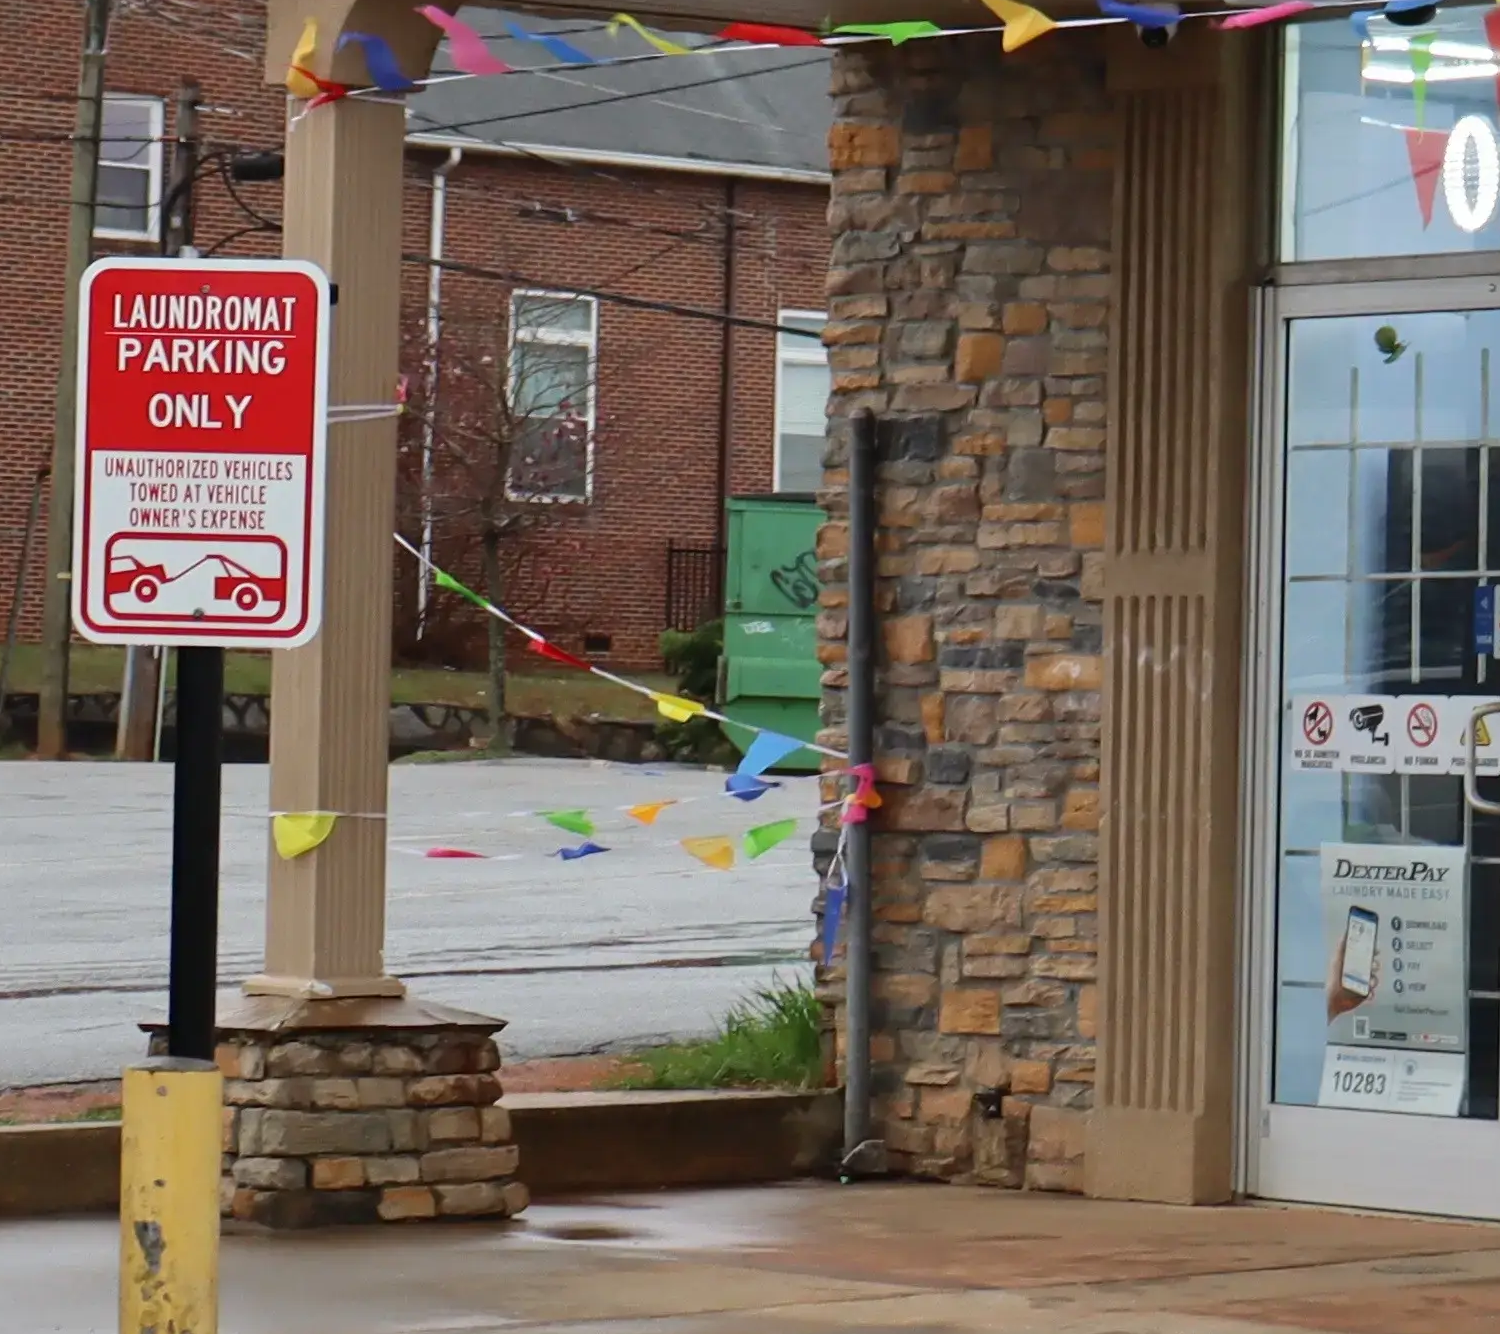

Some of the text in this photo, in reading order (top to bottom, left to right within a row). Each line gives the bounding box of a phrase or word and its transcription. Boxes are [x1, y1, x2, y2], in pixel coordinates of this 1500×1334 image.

[114, 293, 296, 332] LAUNDROMAT
[118, 338, 286, 374] PARKING
[148, 393, 252, 429] ONLY
[105, 457, 293, 481] UNAUTHORIZED VEHICLES
[130, 483, 267, 505] TOWED AT VEHICLE
[130, 508, 265, 530] OWNER'S EXPENSE
[1386, 887, 1416, 899] MADE
[1421, 888, 1450, 900] EASY
[1333, 1071, 1386, 1094] 10283
